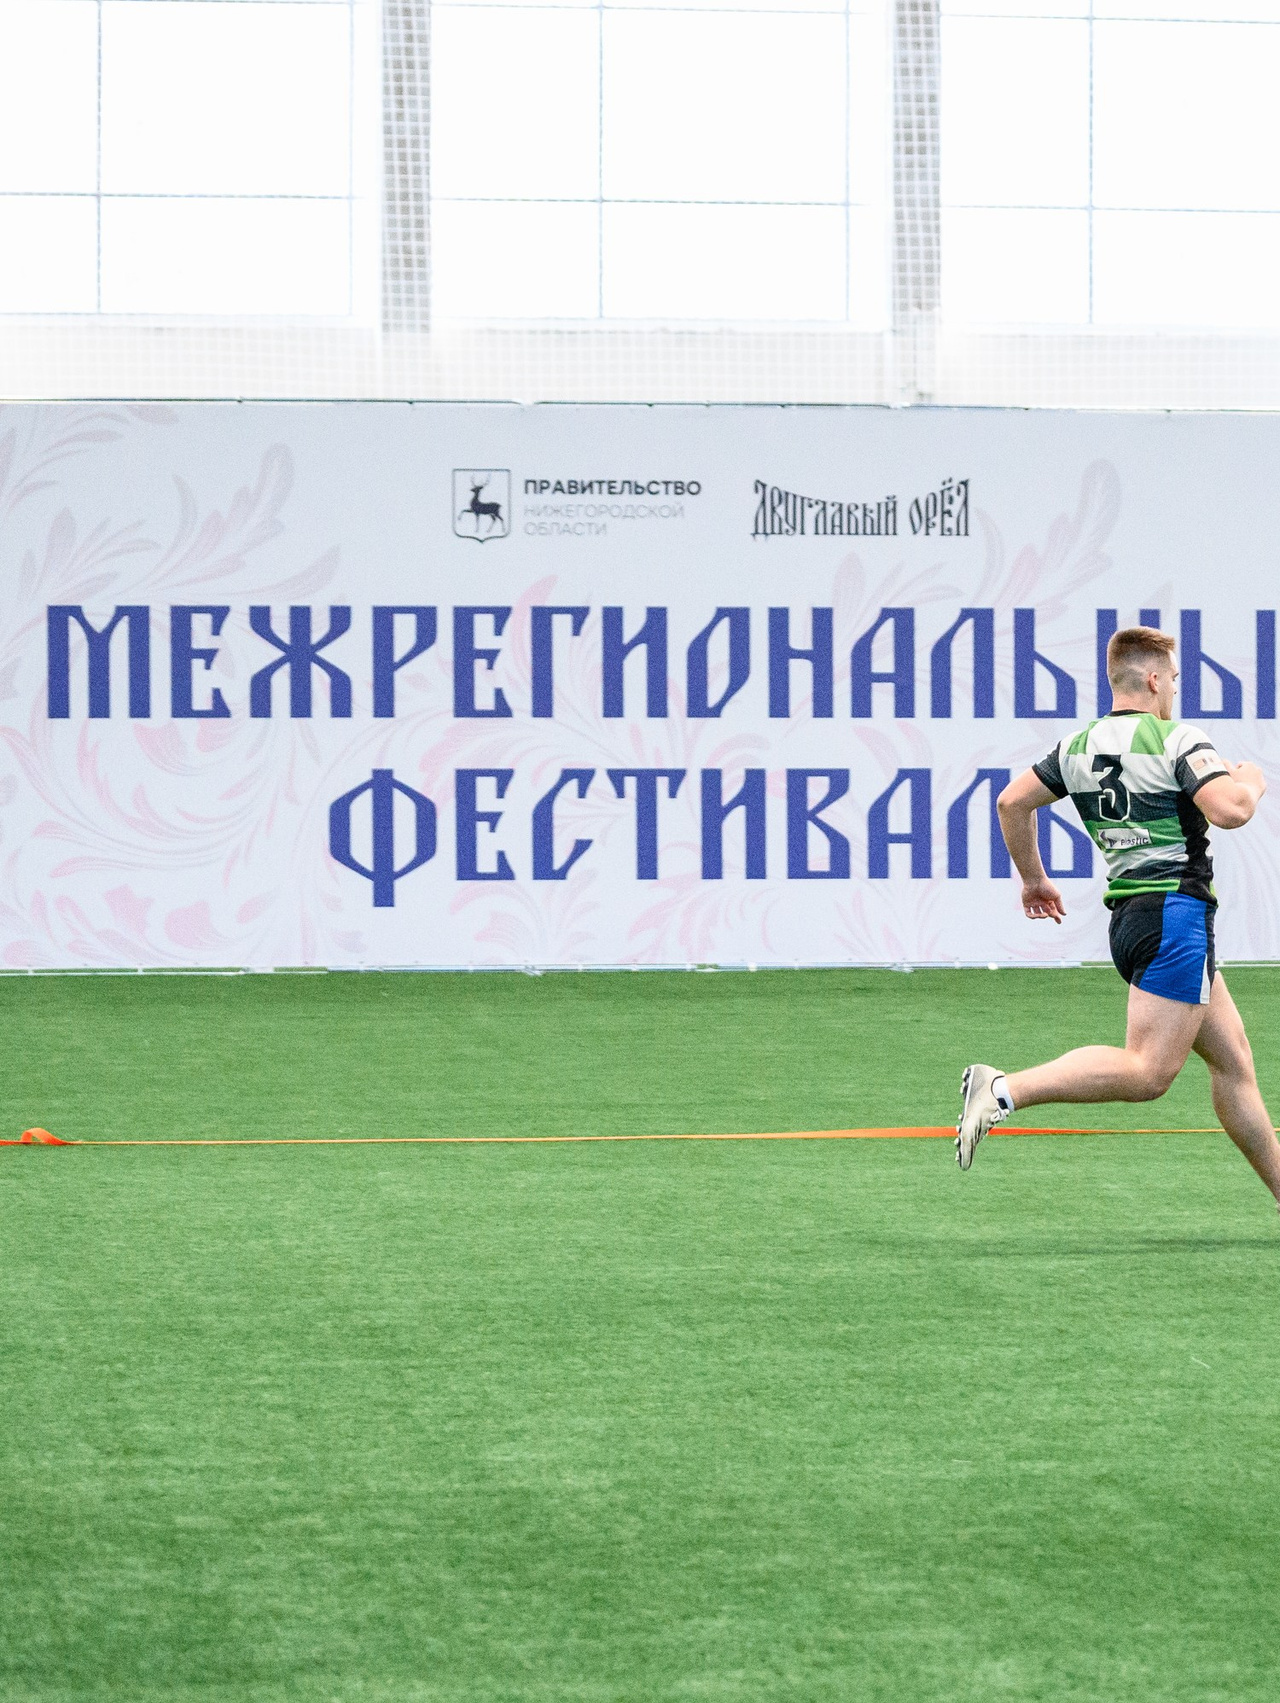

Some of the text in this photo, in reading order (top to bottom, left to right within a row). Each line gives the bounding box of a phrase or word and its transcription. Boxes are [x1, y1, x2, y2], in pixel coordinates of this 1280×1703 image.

[524, 479, 702, 497] ПРАВИТЕЛЬСТВО
[751, 477, 970, 540] ДВУГЛАВЫЙ ОРЁЛ
[524, 501, 686, 520] НИЖЕГОРОДСКОЙ
[524, 522, 608, 537] ОБЛАСТИ
[1092, 754, 1130, 823] 3
[329, 769, 1093, 907] ФЕСТИВАЛЬ
